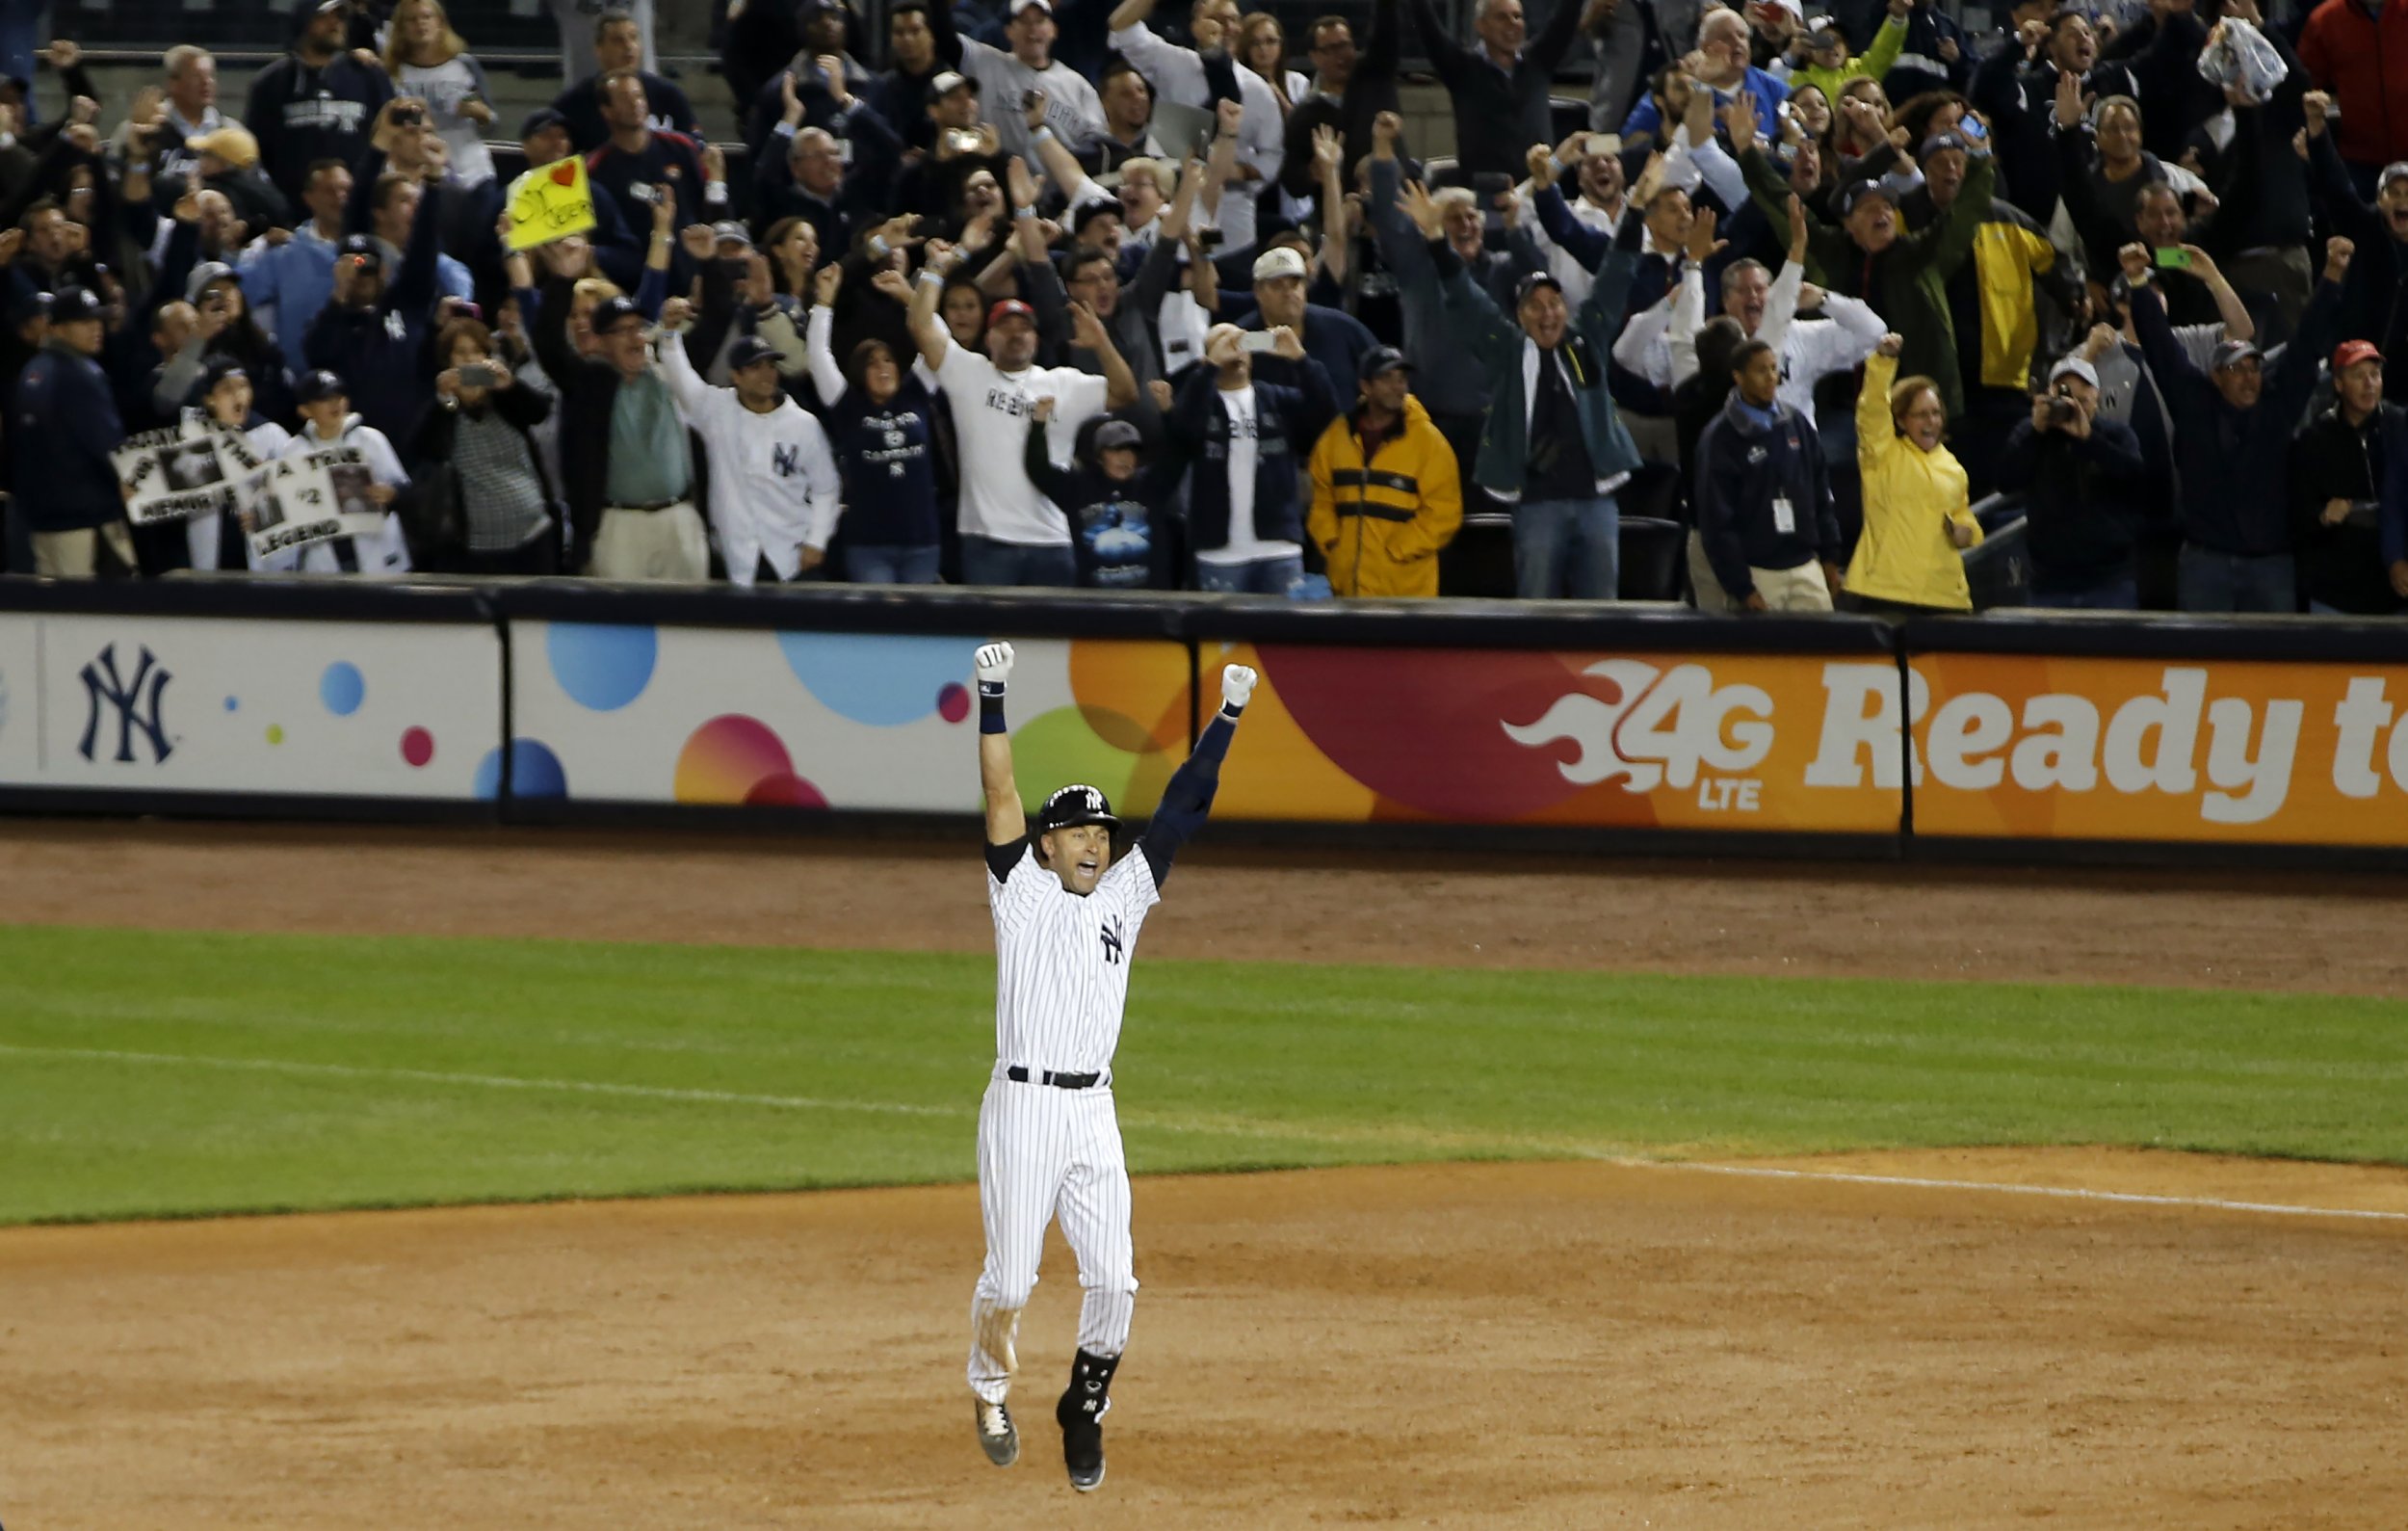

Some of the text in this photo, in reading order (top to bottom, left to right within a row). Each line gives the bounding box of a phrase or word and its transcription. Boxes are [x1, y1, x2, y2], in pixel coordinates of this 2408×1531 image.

[78, 641, 172, 764] NY
[1615, 663, 1775, 789] 4G
[1804, 662, 2408, 825] Ready t
[1086, 792, 1103, 810] NY
[1697, 778, 1764, 810] LTE
[1100, 914, 1123, 965] NY
